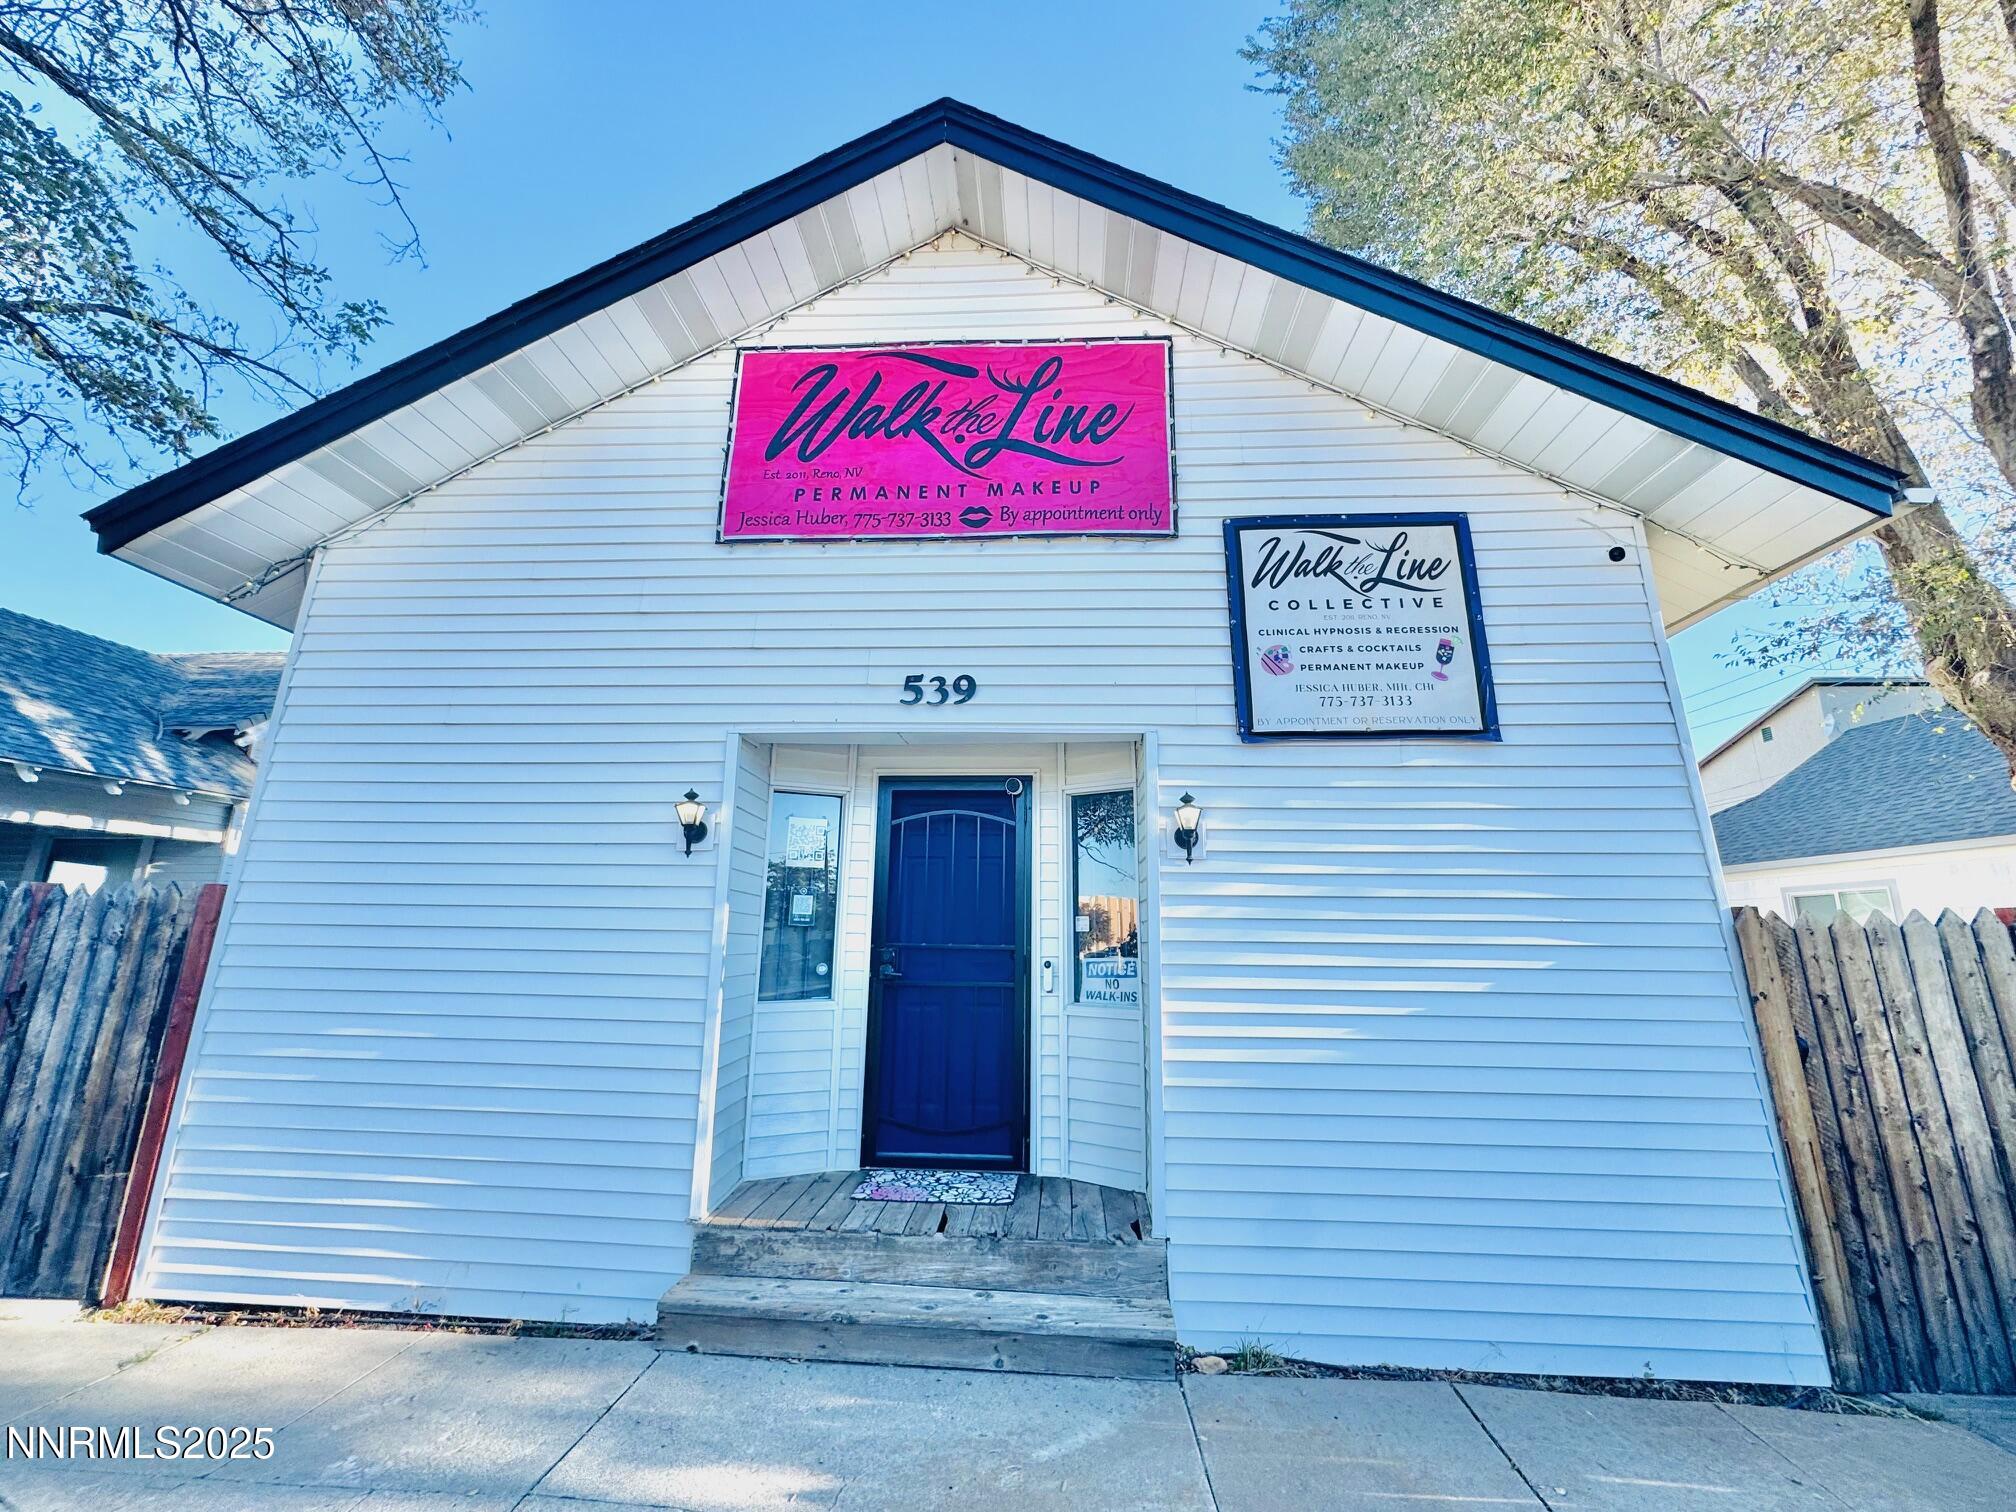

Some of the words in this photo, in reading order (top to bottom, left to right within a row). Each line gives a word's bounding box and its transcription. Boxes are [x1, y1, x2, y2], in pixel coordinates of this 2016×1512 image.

[940, 394, 1005, 437] the
[965, 356, 1135, 469] Line
[764, 363, 990, 479] Walk
[785, 471, 809, 480] 2011,
[813, 468, 841, 479] Reno,
[845, 468, 863, 477] NV
[794, 484, 967, 502] PERMANENT
[987, 480, 1100, 497] MAKEUP
[736, 511, 791, 531] Jessica
[796, 508, 849, 528] Huber,
[854, 512, 951, 528] 775-737-3133
[1000, 505, 1017, 526] By
[1023, 506, 1125, 526] appointment
[1129, 503, 1162, 526] only
[1251, 536, 1373, 599] Walk
[1344, 553, 1378, 575] the
[1360, 531, 1452, 593] Line
[1268, 597, 1444, 611] COLLECTIVE
[1258, 628, 1310, 636] CLINICAL
[1313, 627, 1371, 635] HYPNOSIS
[1386, 626, 1459, 634] REGRESSION
[1299, 645, 1343, 653] CRAFTS
[1347, 645, 1354, 653] &
[1357, 644, 1422, 652] COCKTAILS
[1300, 663, 1371, 672] PERMANENT
[1375, 662, 1424, 671] MAKEUP
[899, 673, 977, 706] 539
[1295, 683, 1338, 692] JESSICA
[1319, 695, 1413, 707] 775-737-3133
[1257, 718, 1270, 726] BY
[1276, 717, 1348, 726] APPOINTMENT
[1353, 716, 1369, 725] OR
[1371, 716, 1446, 725] RESERVATION
[1450, 716, 1477, 724] ONLY
[1105, 978, 1120, 990] NO
[1086, 991, 1138, 1002] WALK-INS
